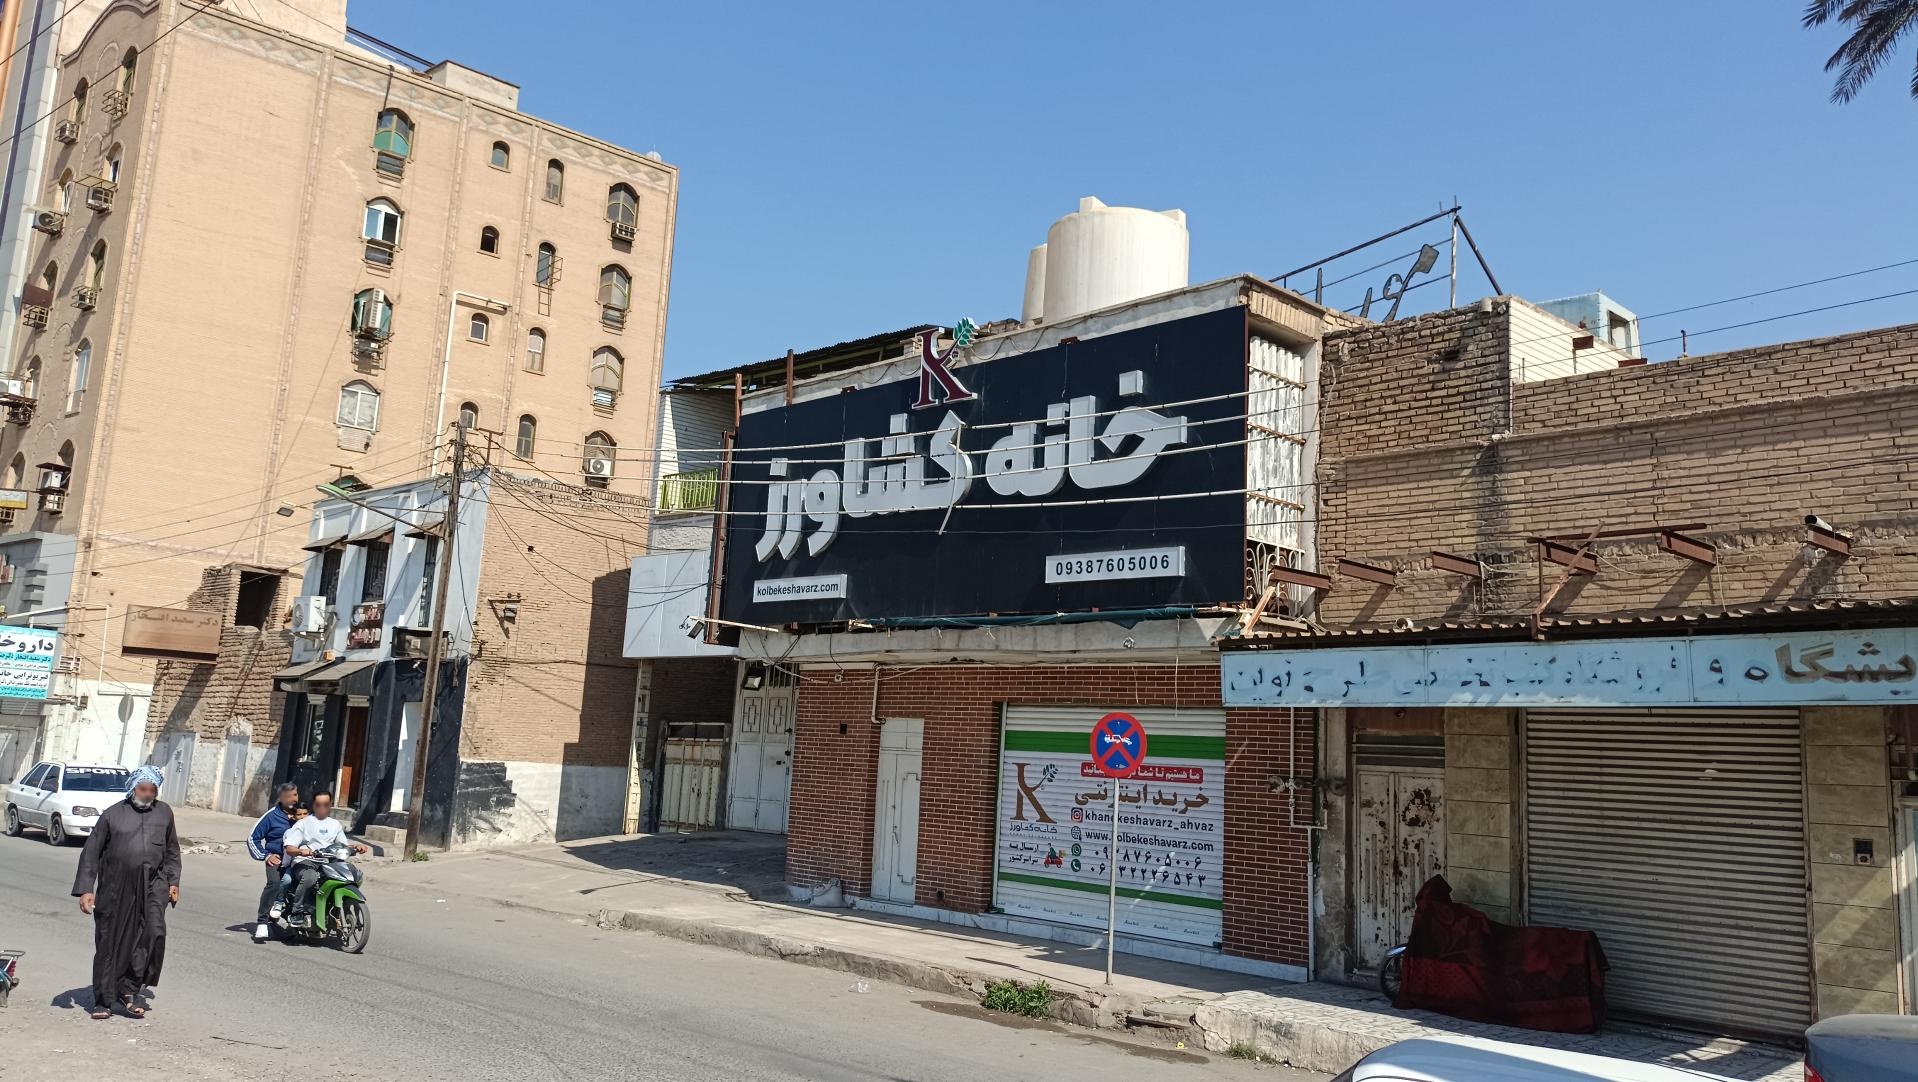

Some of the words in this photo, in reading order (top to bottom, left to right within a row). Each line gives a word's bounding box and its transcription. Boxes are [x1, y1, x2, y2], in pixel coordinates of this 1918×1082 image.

[912, 326, 978, 409] K
[985, 370, 1187, 496] خانه
[756, 410, 973, 562] کشاورز
[1056, 555, 1169, 575] 09387605006
[757, 583, 838, 596] kolbekeshavarz.com
[171, 616, 194, 625] سعید
[197, 617, 218, 628] دکتر
[66, 767, 127, 776] SPORT
[1138, 766, 1154, 777] شما
[1155, 767, 1165, 778] تا
[1166, 769, 1188, 780] هستیم
[1189, 769, 1201, 779] ما
[1010, 762, 1057, 824] K
[1153, 786, 1209, 814] خرید
[1009, 822, 1034, 832] کشاورز
[1034, 824, 1057, 834] خانه
[1085, 831, 1214, 852] www.olbekeshavarz.com
[1020, 842, 1039, 853] ارسال
[1009, 853, 1023, 863] کشور
[1023, 855, 1039, 865] سراسر
